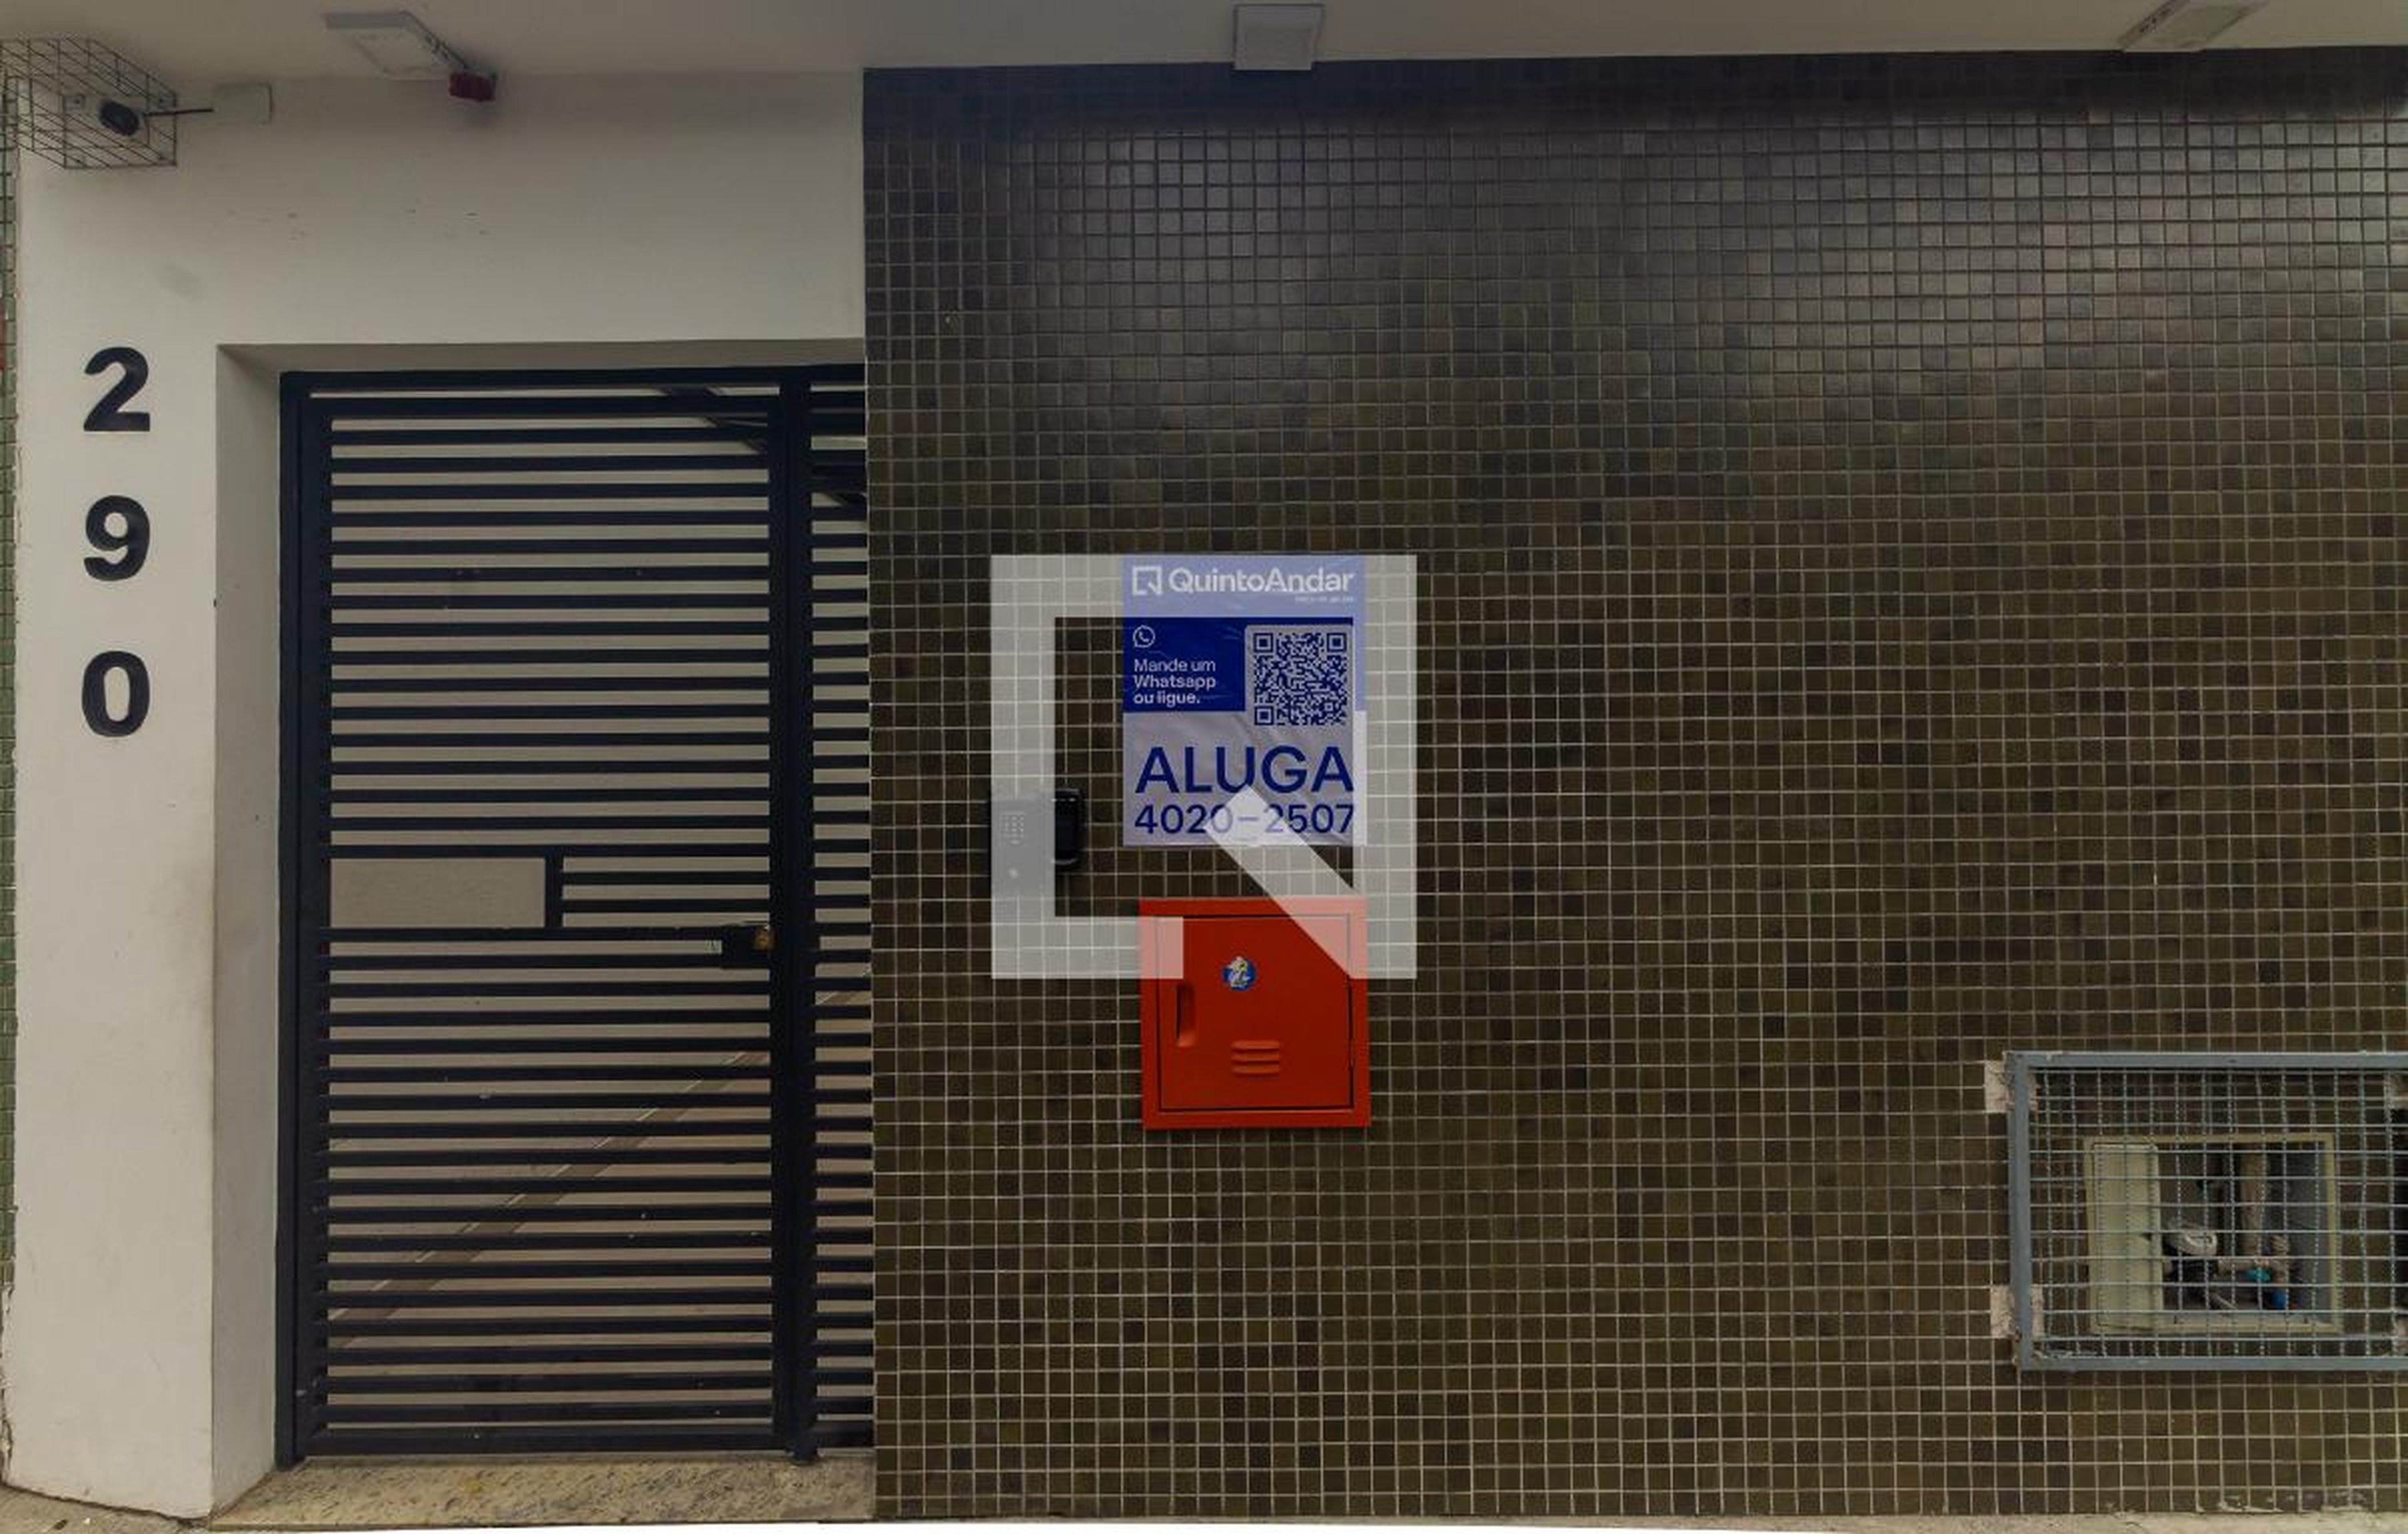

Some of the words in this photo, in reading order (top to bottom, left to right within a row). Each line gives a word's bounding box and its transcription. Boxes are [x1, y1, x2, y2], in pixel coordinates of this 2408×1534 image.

[81, 346, 151, 737] 290
[1168, 567, 1356, 593] QuintoAndar
[1134, 658, 1187, 672] Mande
[1191, 660, 1217, 672] um
[1133, 675, 1217, 690] Whatsapp
[1133, 693, 1154, 704] ou
[1156, 690, 1201, 708] ligue.
[1135, 745, 1354, 794] ALUGA
[1134, 804, 1355, 834] 4020-2507
